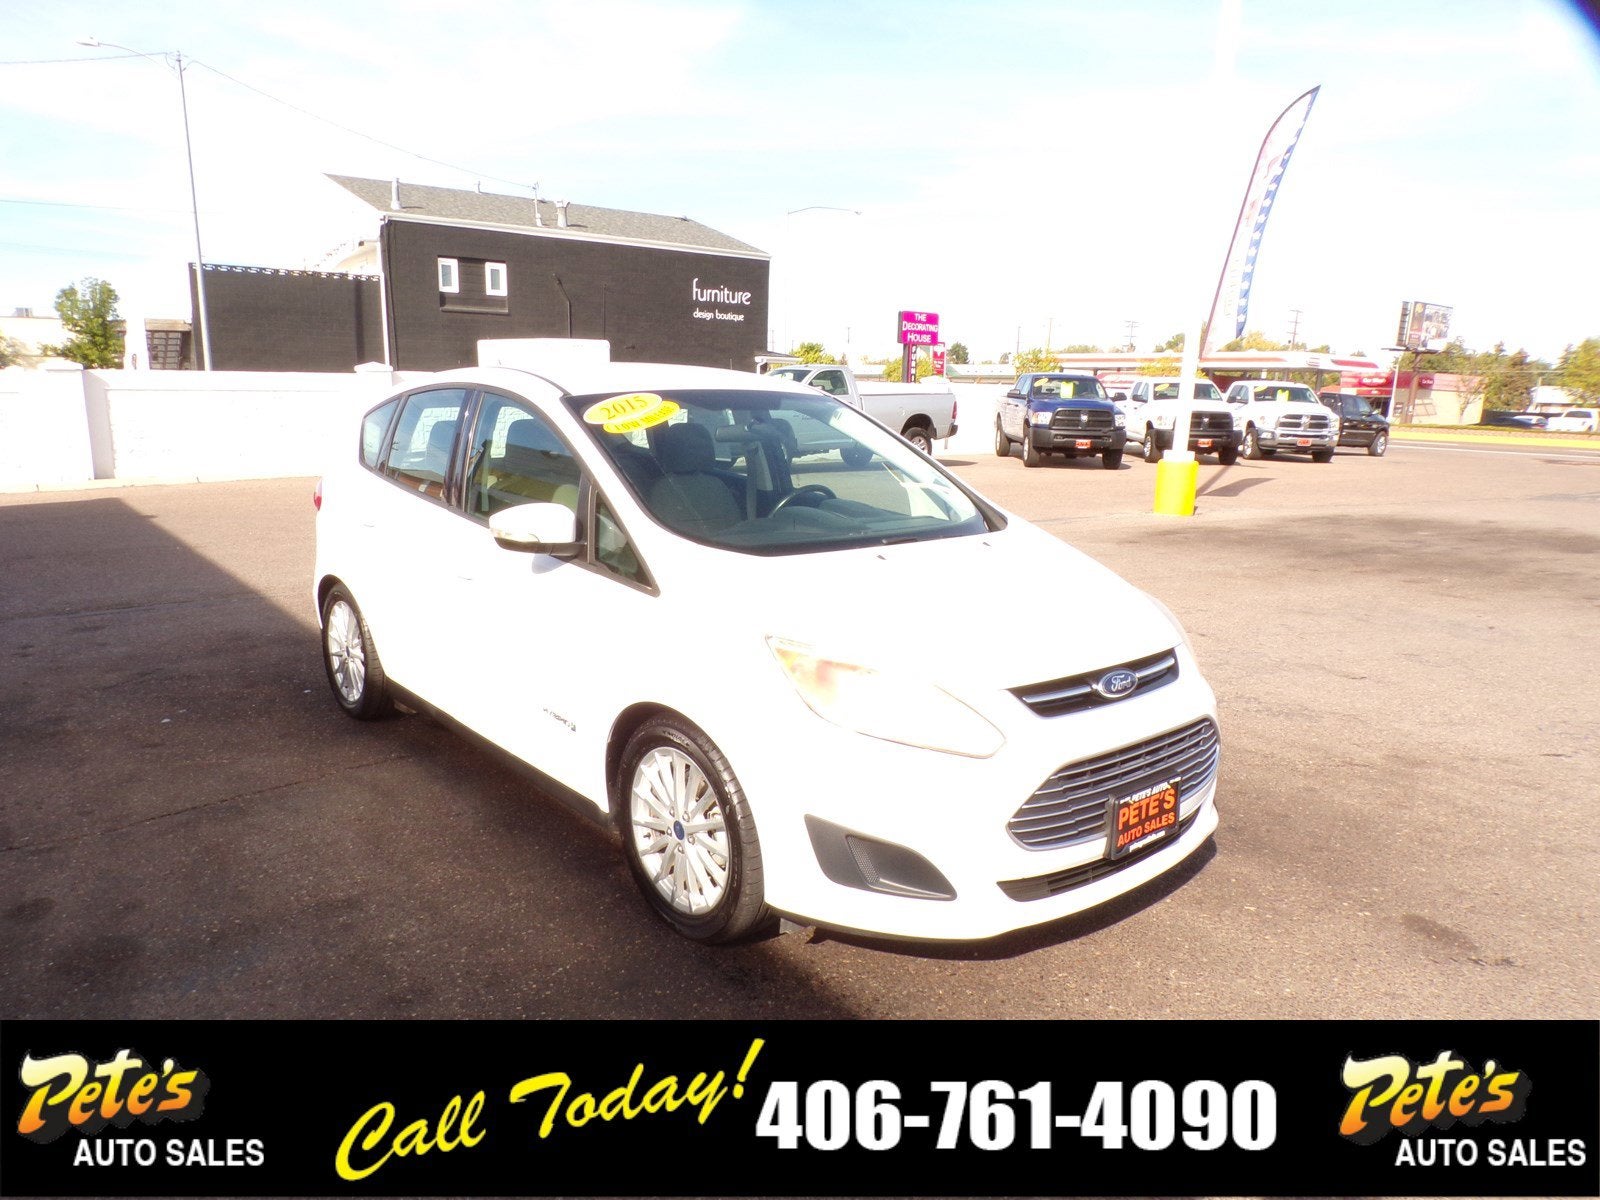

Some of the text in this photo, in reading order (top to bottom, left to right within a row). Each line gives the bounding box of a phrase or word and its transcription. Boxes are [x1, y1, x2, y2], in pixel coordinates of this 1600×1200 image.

[693, 278, 751, 305] furniture
[693, 307, 745, 322] design boutique
[915, 313, 927, 322] THE
[902, 321, 938, 332] DECORATING
[908, 333, 931, 342] HOUSE
[601, 396, 648, 420] 2015
[1111, 674, 1132, 692] Ford
[1118, 788, 1176, 831] PETE'S
[1117, 825, 1143, 848] AUTO
[1144, 811, 1176, 834] SALES
